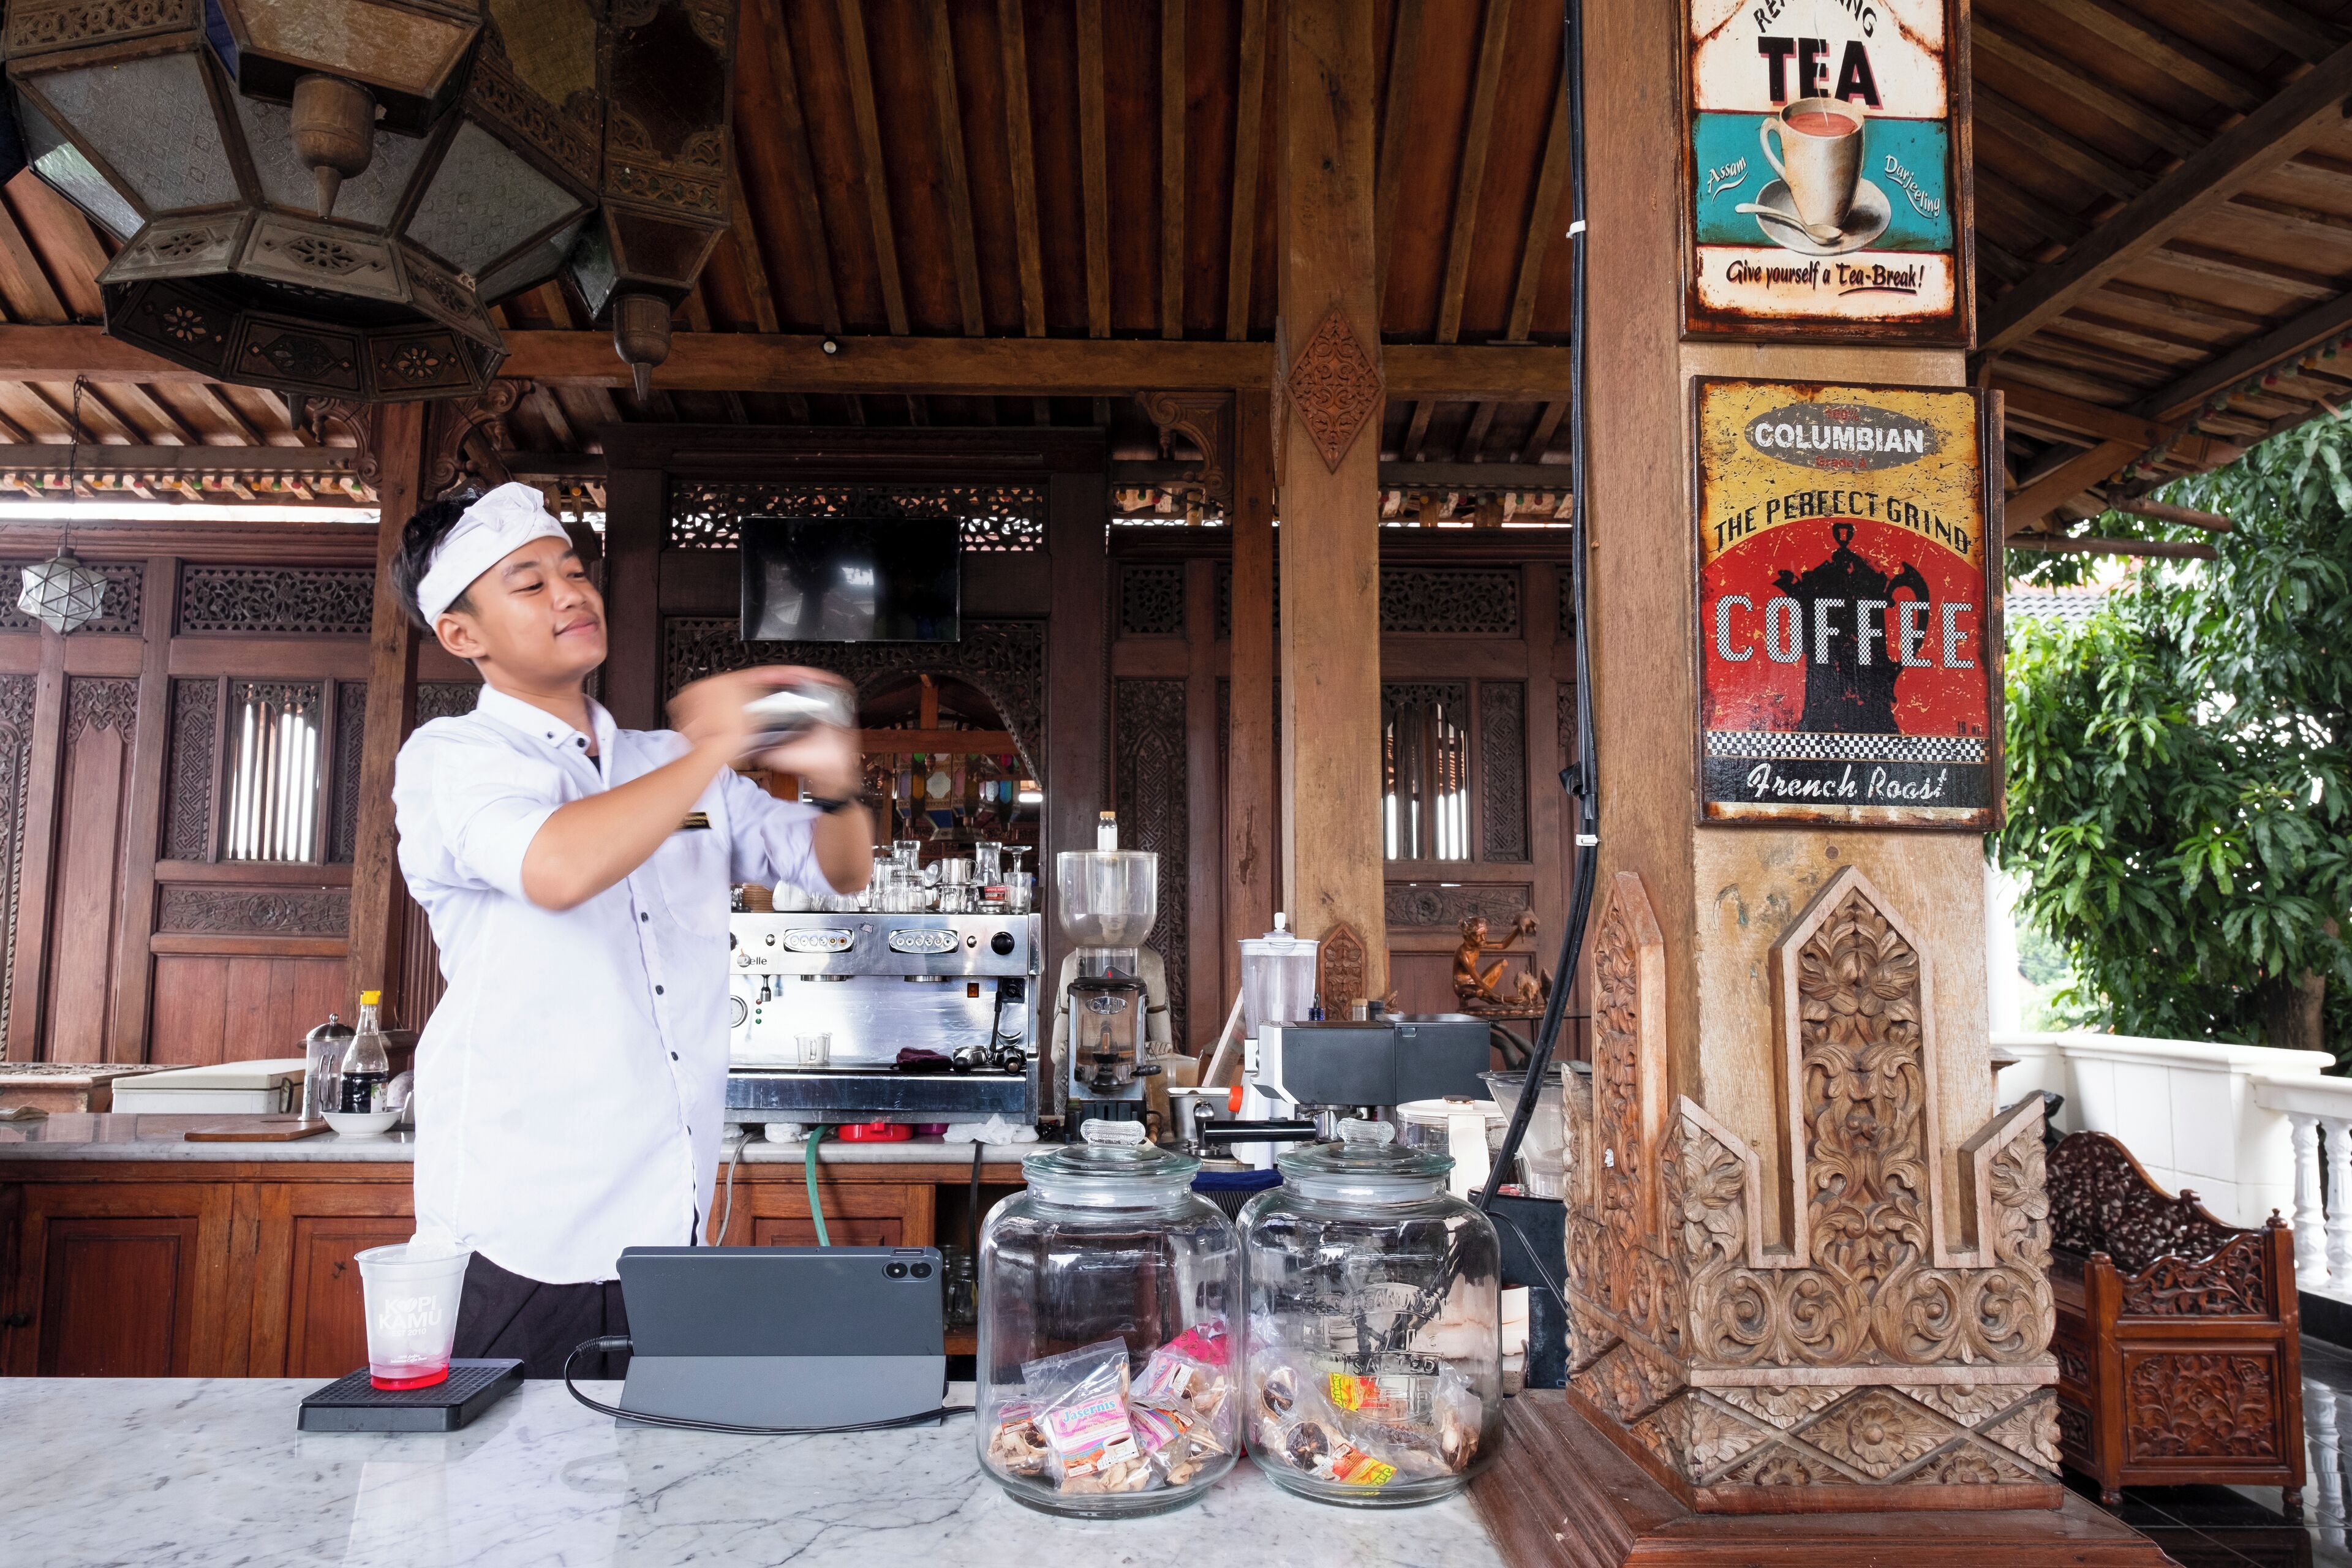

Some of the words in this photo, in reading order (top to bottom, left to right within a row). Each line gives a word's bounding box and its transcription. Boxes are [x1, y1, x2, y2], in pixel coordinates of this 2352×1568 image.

[1758, 36, 1883, 109] TEA
[1707, 156, 1747, 194] Assam
[1885, 154, 1941, 217] Darjeeling
[1726, 260, 1762, 284] Give
[1766, 262, 1820, 291] yourself
[1823, 270, 1830, 285] a
[1754, 423, 1924, 453] COLUMBIAN
[1816, 455, 1854, 468] Grade
[1858, 457, 1867, 469] A
[1714, 505, 1757, 553] THE
[1766, 490, 1879, 526] PERFECT
[1887, 498, 1970, 555] GRIND
[1716, 595, 1975, 669] COFFEE
[1747, 763, 1858, 798] French
[1868, 766, 1947, 801] Roast
[379, 1308, 442, 1330] KAMU
[1063, 1399, 1116, 1423] Jasernis
